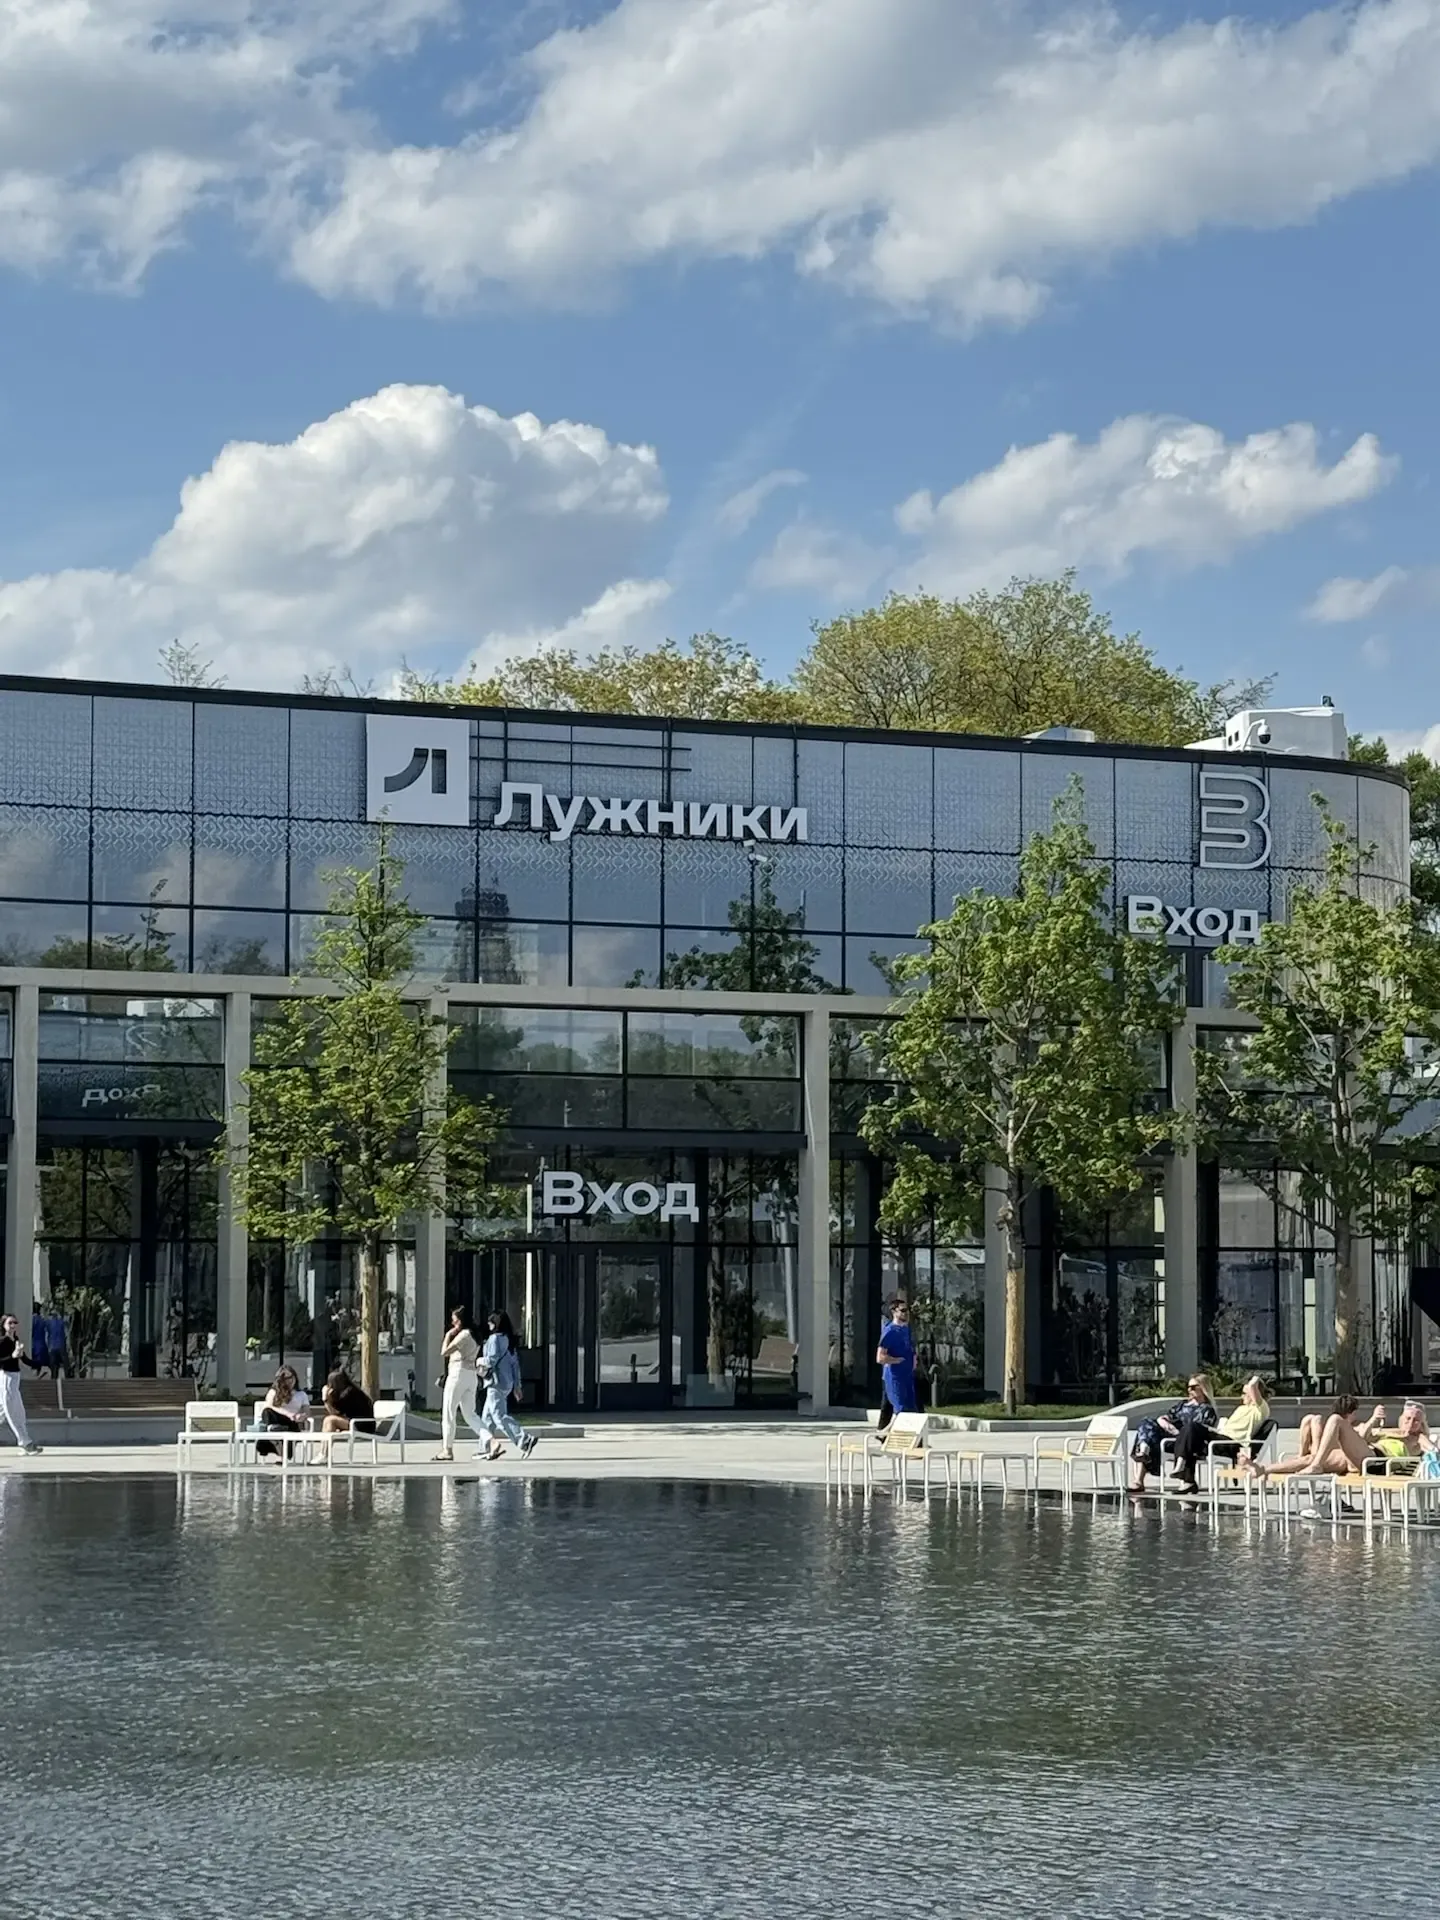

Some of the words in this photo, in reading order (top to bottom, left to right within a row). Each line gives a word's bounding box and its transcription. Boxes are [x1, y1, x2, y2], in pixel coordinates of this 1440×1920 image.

[494, 782, 807, 842] Лужники
[1200, 772, 1272, 869] 3
[1128, 895, 1261, 945] Вход
[543, 1171, 699, 1223] Вход
